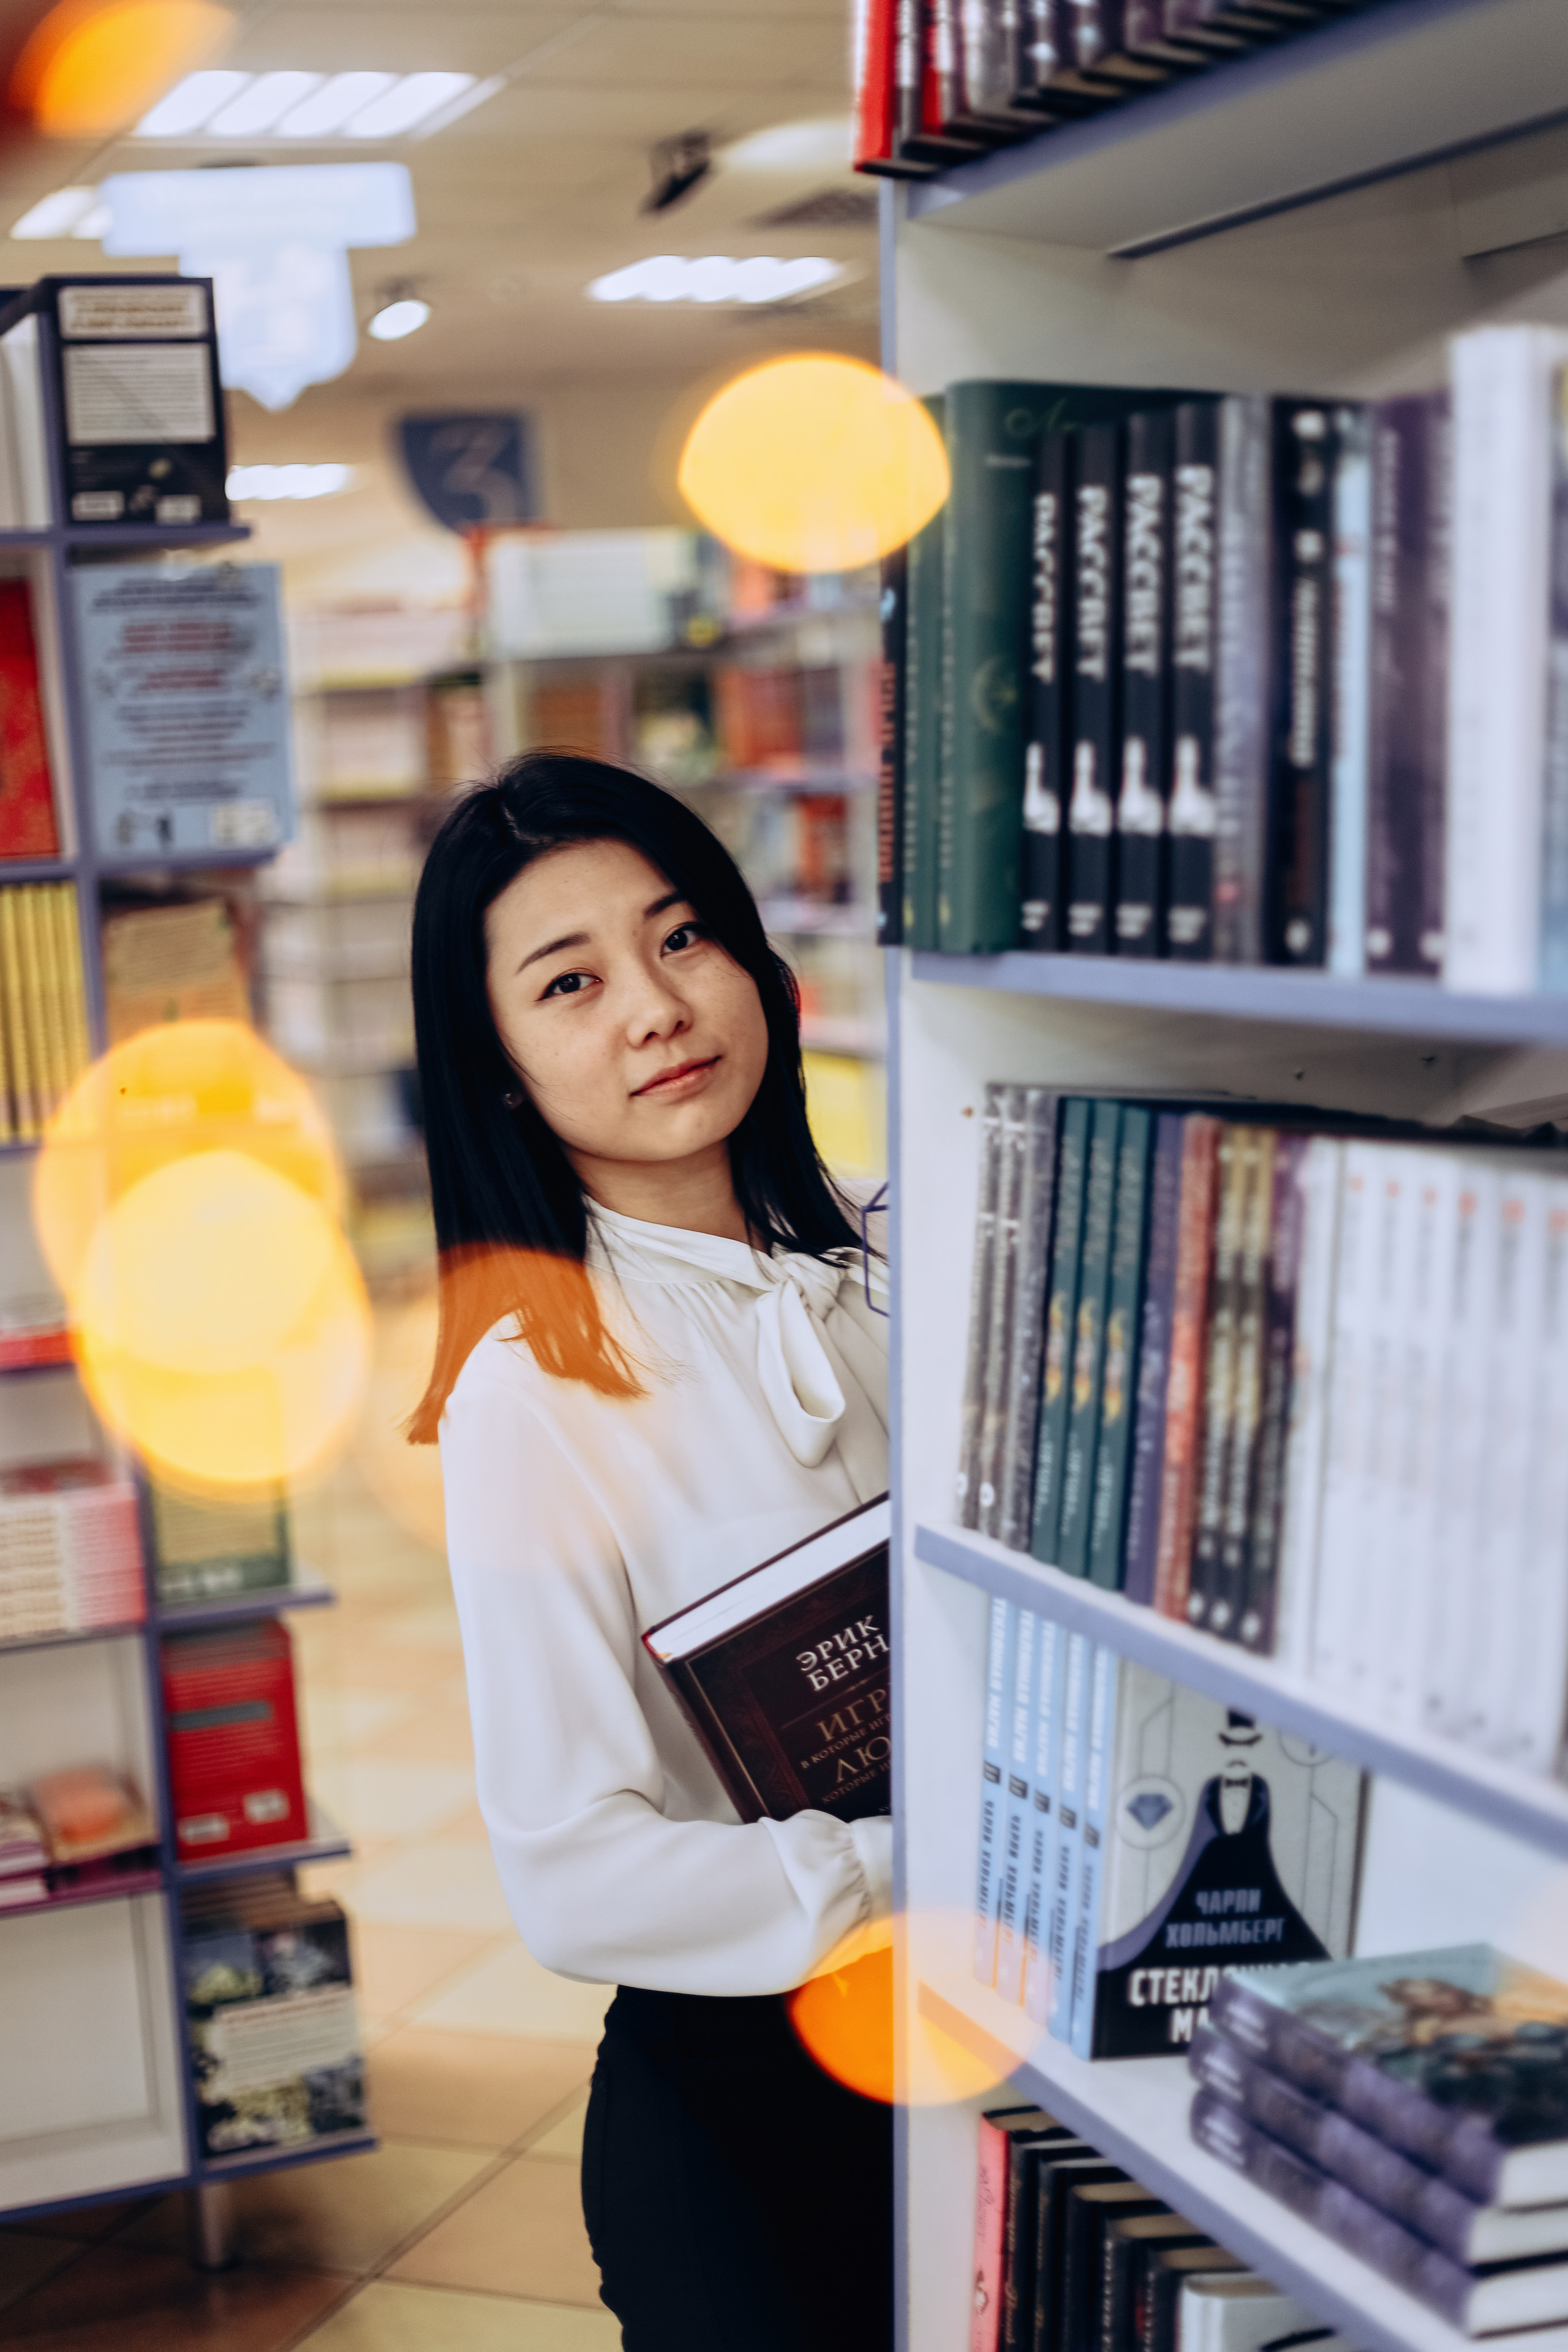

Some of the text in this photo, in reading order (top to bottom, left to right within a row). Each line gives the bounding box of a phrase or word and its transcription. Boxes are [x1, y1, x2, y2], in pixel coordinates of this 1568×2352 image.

[796, 1614, 880, 1672] ЭРИК
[806, 1634, 890, 1692] БЕРН
[989, 1596, 1008, 1691] ТЕКЛЯННАЯ
[1015, 1608, 1035, 1705] ТЕКЛЯННАЯ
[1038, 1619, 1057, 1718] ТЕКЛЯННАЯ
[815, 1688, 887, 1742] ИГР
[835, 1736, 891, 1783] ЛЮ
[1194, 1888, 1262, 1915] ЧАРЛИ
[1164, 1917, 1286, 1948] ХОЛЬМБЕРГ
